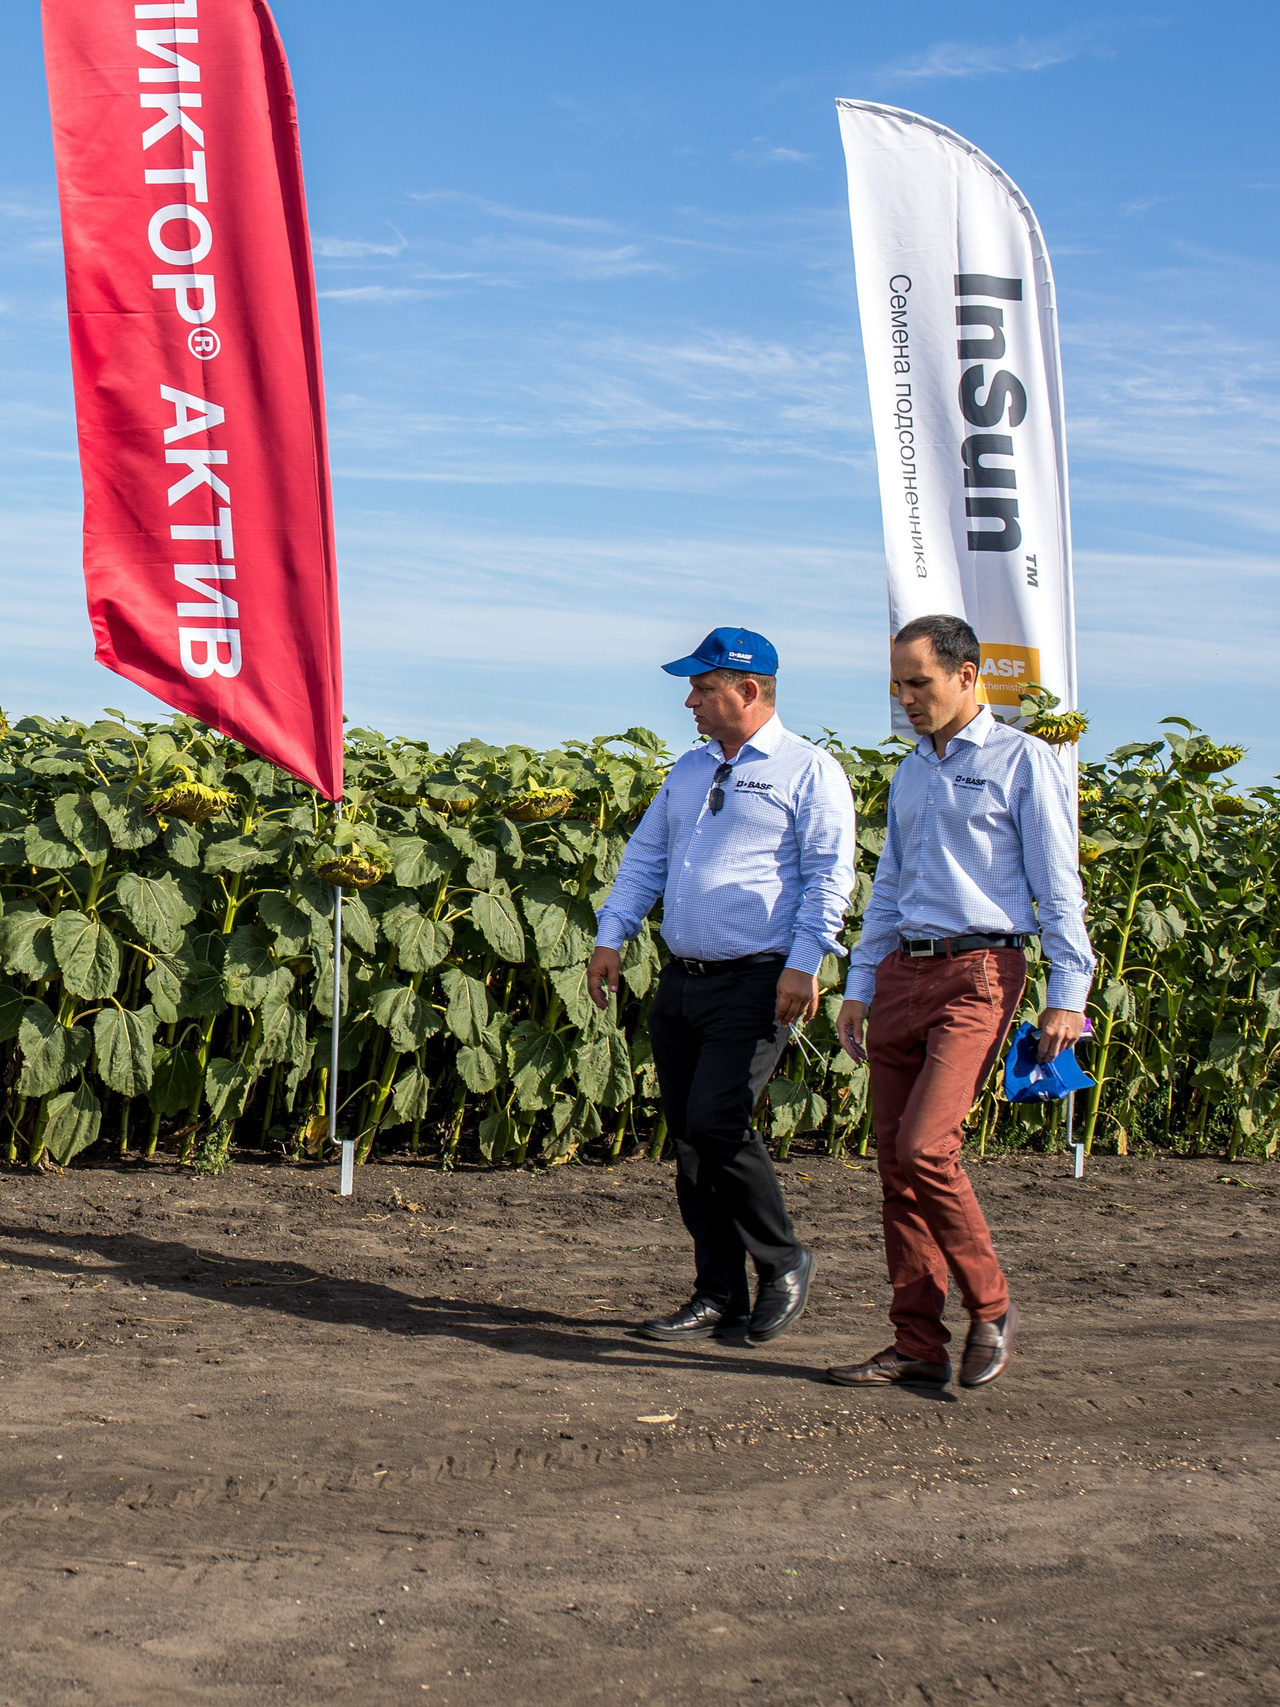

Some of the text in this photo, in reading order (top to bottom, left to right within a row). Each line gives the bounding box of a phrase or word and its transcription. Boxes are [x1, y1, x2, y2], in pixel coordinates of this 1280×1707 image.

[889, 274, 928, 579] Семена подсолнечника
[160, 383, 243, 679] АКТИВ
[978, 658, 1026, 677] ASF
[982, 682, 1026, 694] chemistry
[747, 781, 774, 790] BASF
